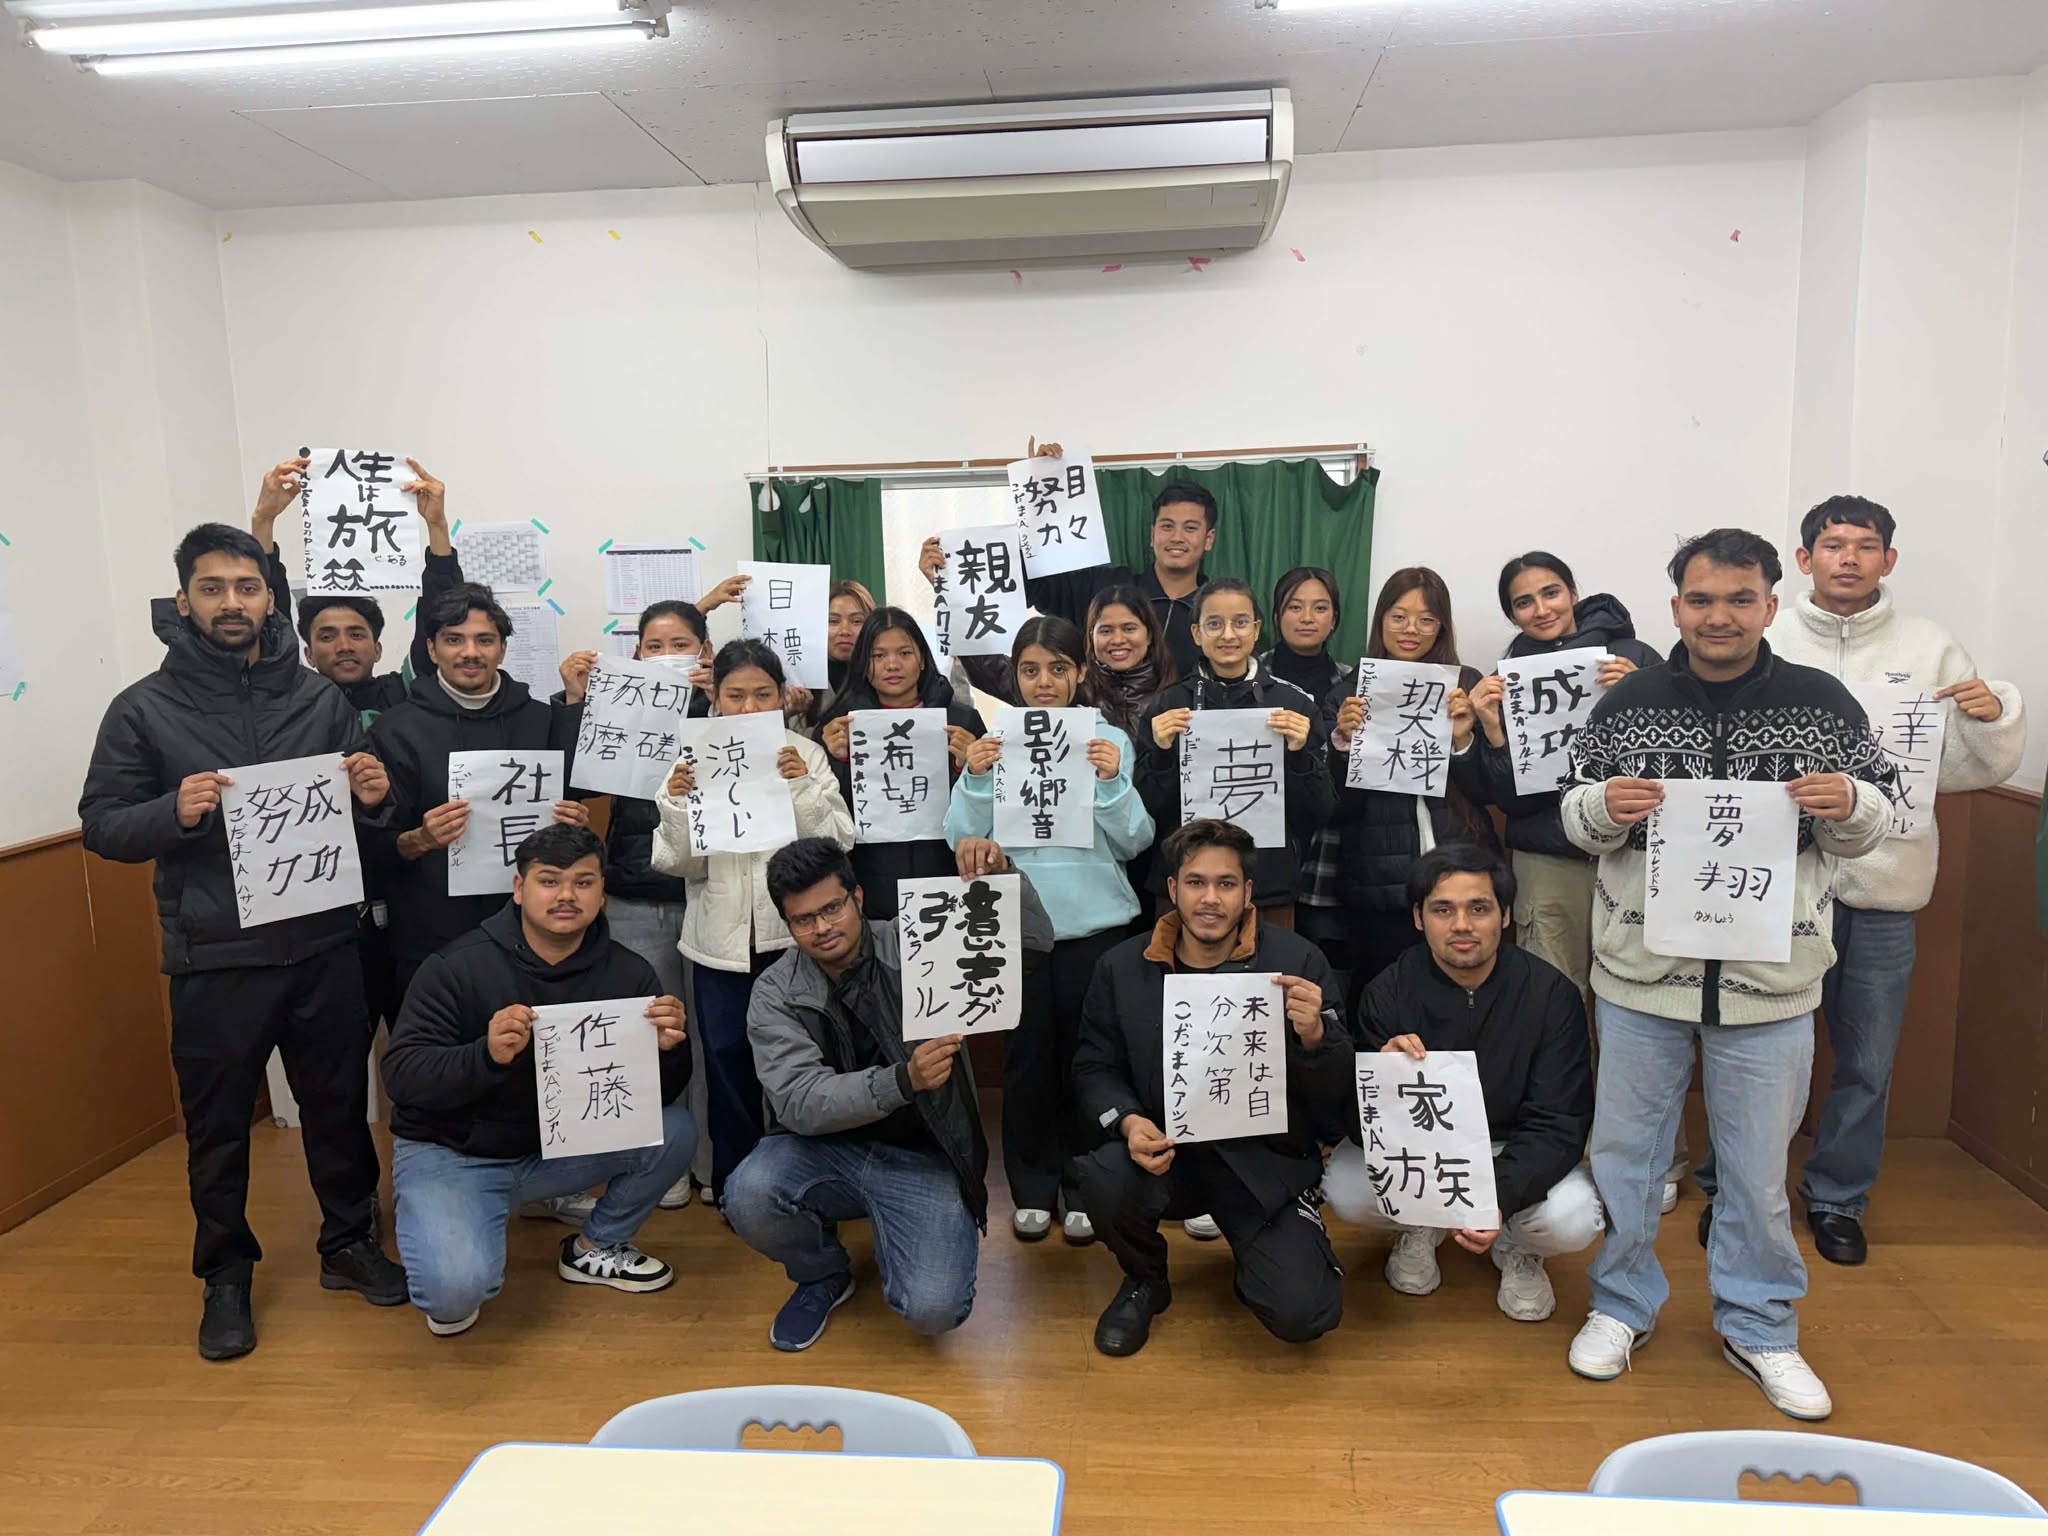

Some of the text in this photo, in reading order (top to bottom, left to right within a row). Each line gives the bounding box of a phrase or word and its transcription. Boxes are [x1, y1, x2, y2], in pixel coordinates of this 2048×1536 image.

[325, 449, 395, 483] 人生
[358, 484, 381, 502] は
[1023, 476, 1065, 546] 努力
[327, 503, 408, 553] 旅
[763, 579, 803, 666] 目標
[956, 540, 1017, 640] 親友
[1382, 678, 1447, 791] 契機
[1528, 665, 1592, 758] 成功
[491, 757, 552, 867] 社長
[706, 736, 752, 839] 涼しい
[880, 719, 929, 814] 希望
[1206, 738, 1279, 822] 夢
[245, 783, 302, 896] 努力
[294, 774, 343, 882] 成功
[950, 880, 1007, 1027] 意志が
[1693, 910, 1735, 924] ゆめしょう
[570, 1012, 634, 1121] 佐藤
[1202, 995, 1238, 1105] 分次第
[1242, 996, 1274, 1117] 未来は自
[1383, 1070, 1475, 1209] 家族
